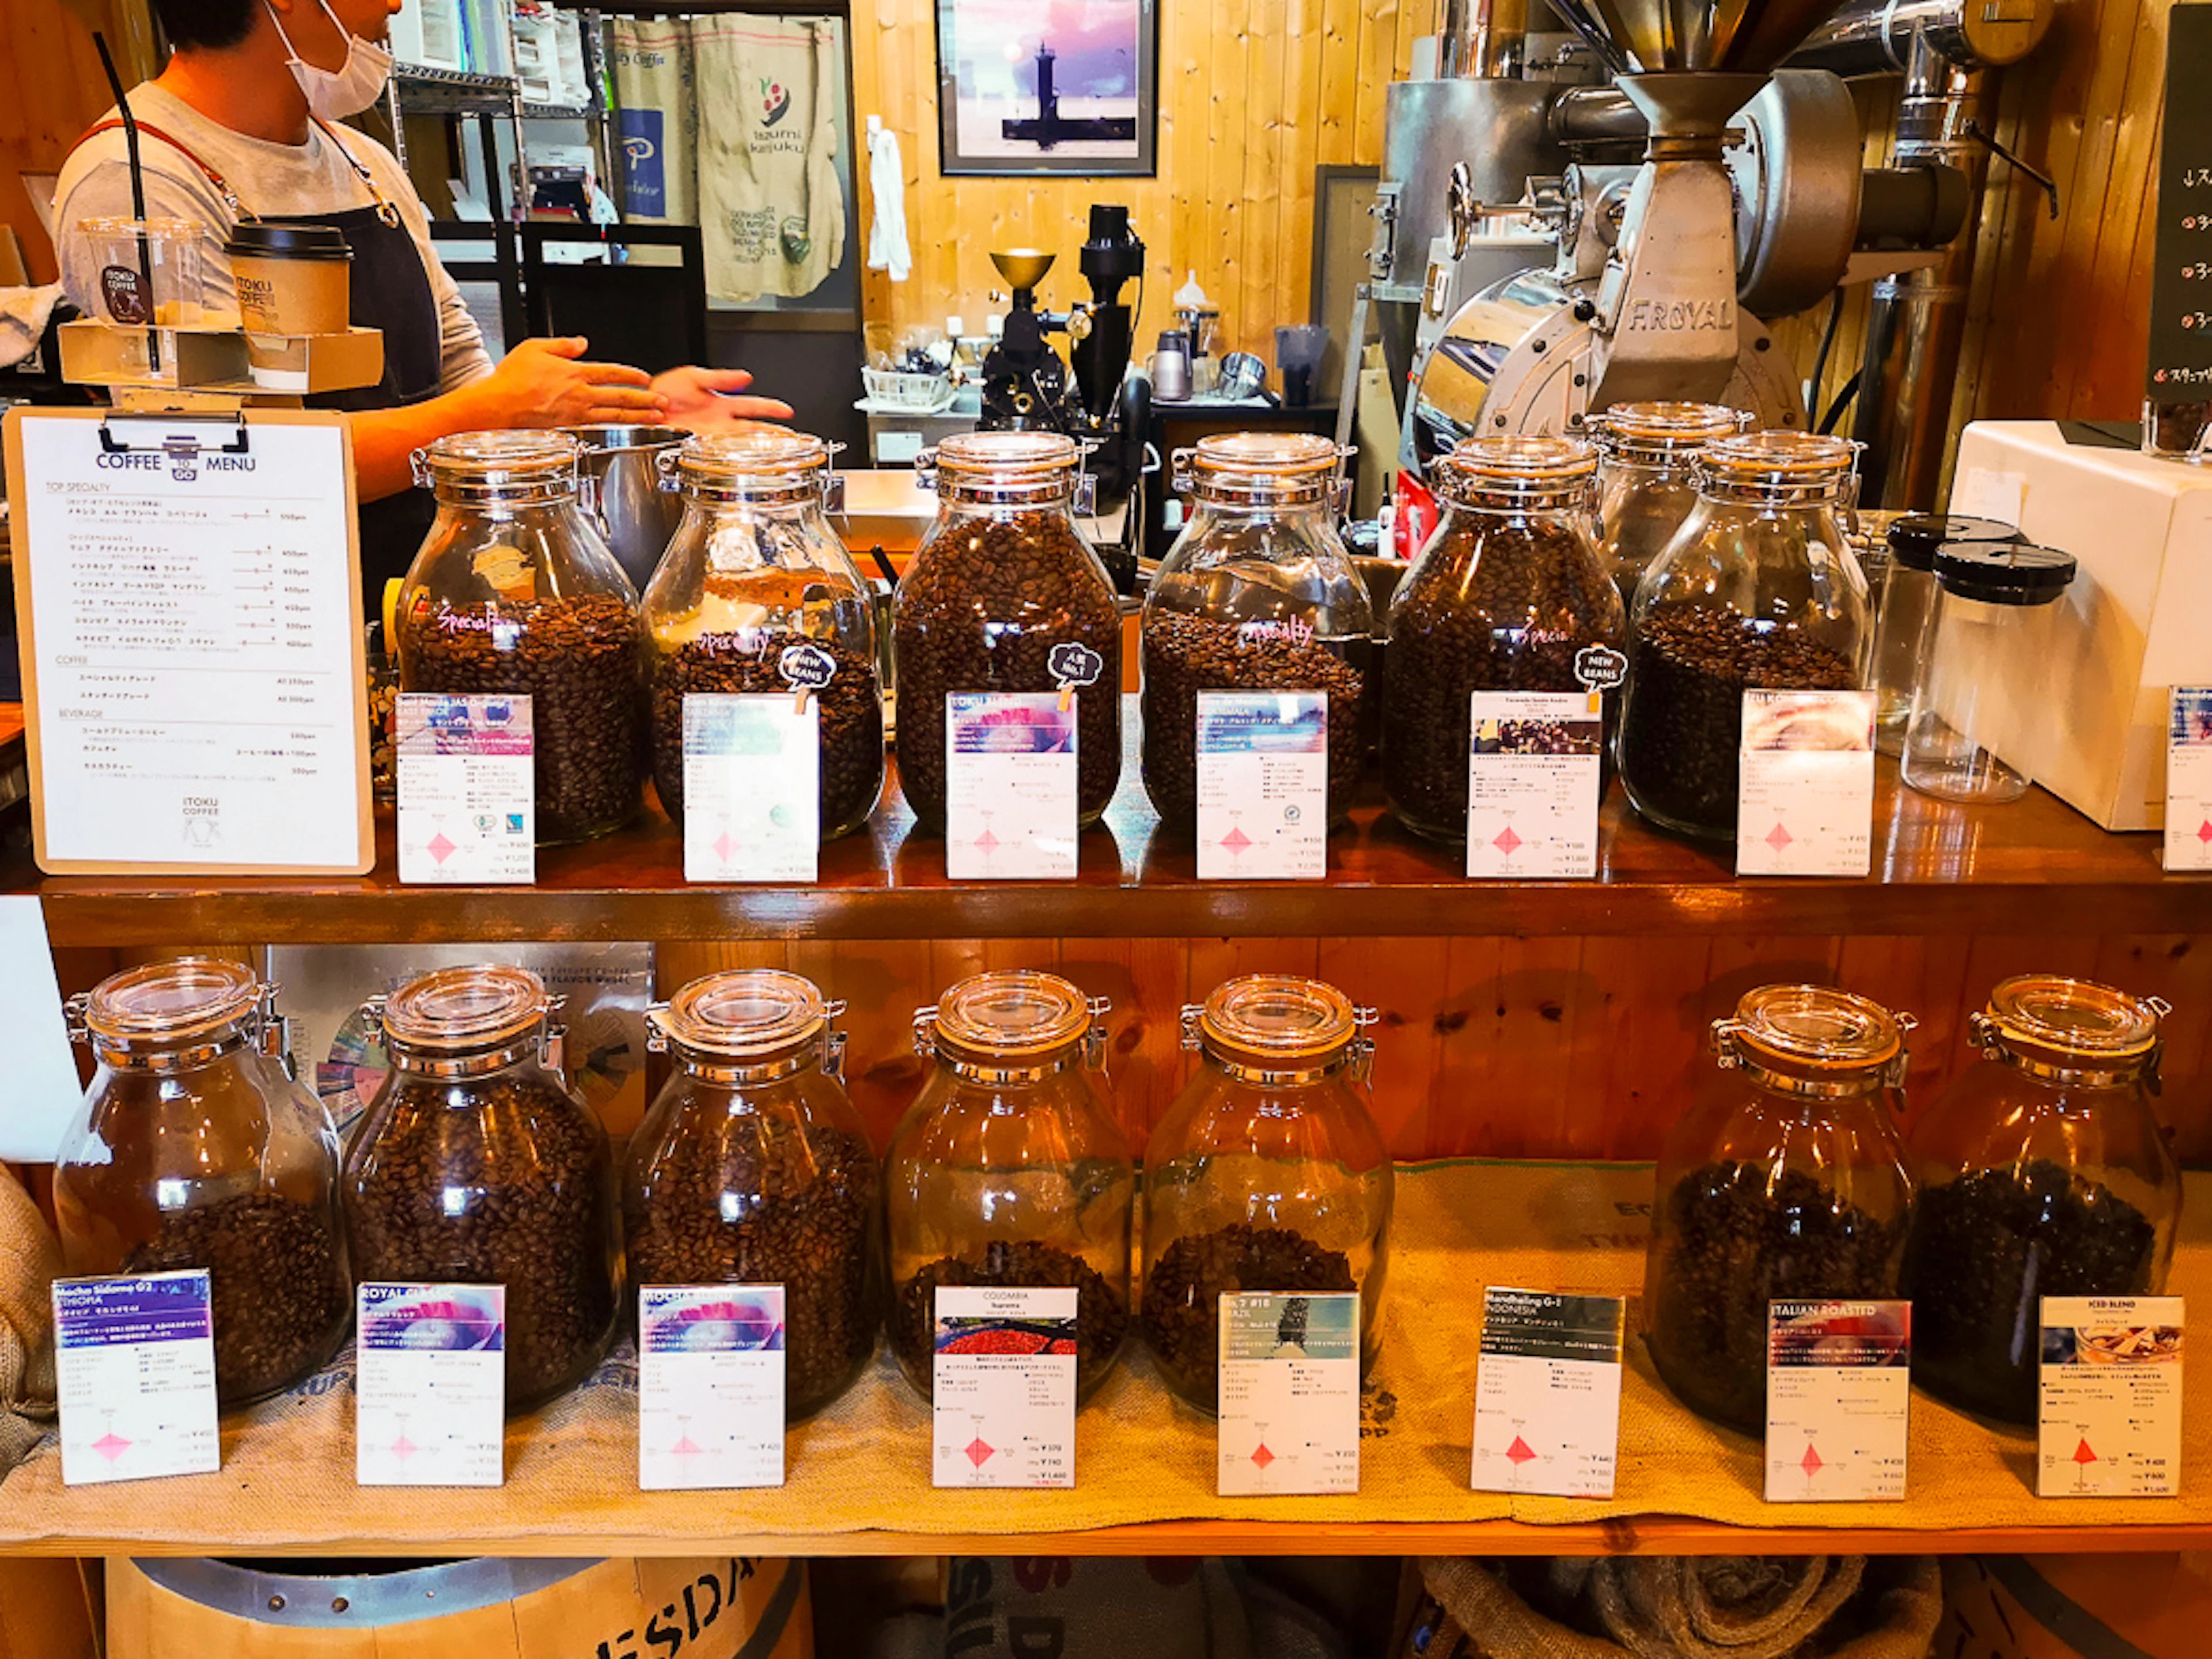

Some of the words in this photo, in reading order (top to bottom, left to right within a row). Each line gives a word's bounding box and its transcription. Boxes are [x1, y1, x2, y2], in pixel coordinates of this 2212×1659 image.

[96, 454, 162, 471] COFFEE
[206, 457, 256, 472] MENU
[46, 483, 64, 492] TOP
[1588, 656, 1613, 666] NEW
[1584, 668, 1618, 680] BEANS
[183, 797, 219, 806] ITOKU
[183, 807, 219, 816] COFFEE
[361, 1287, 401, 1299] ROYAL
[982, 1291, 1029, 1300] COLOMBIA
[1484, 1293, 1543, 1308] Mandheling
[2088, 1300, 2107, 1308] ICED
[2109, 1300, 2136, 1308] BLEND
[1484, 1303, 1537, 1316] INDONESIA
[1771, 1305, 1819, 1316] ITALIAN
[1820, 1305, 1877, 1316] ROASTED
